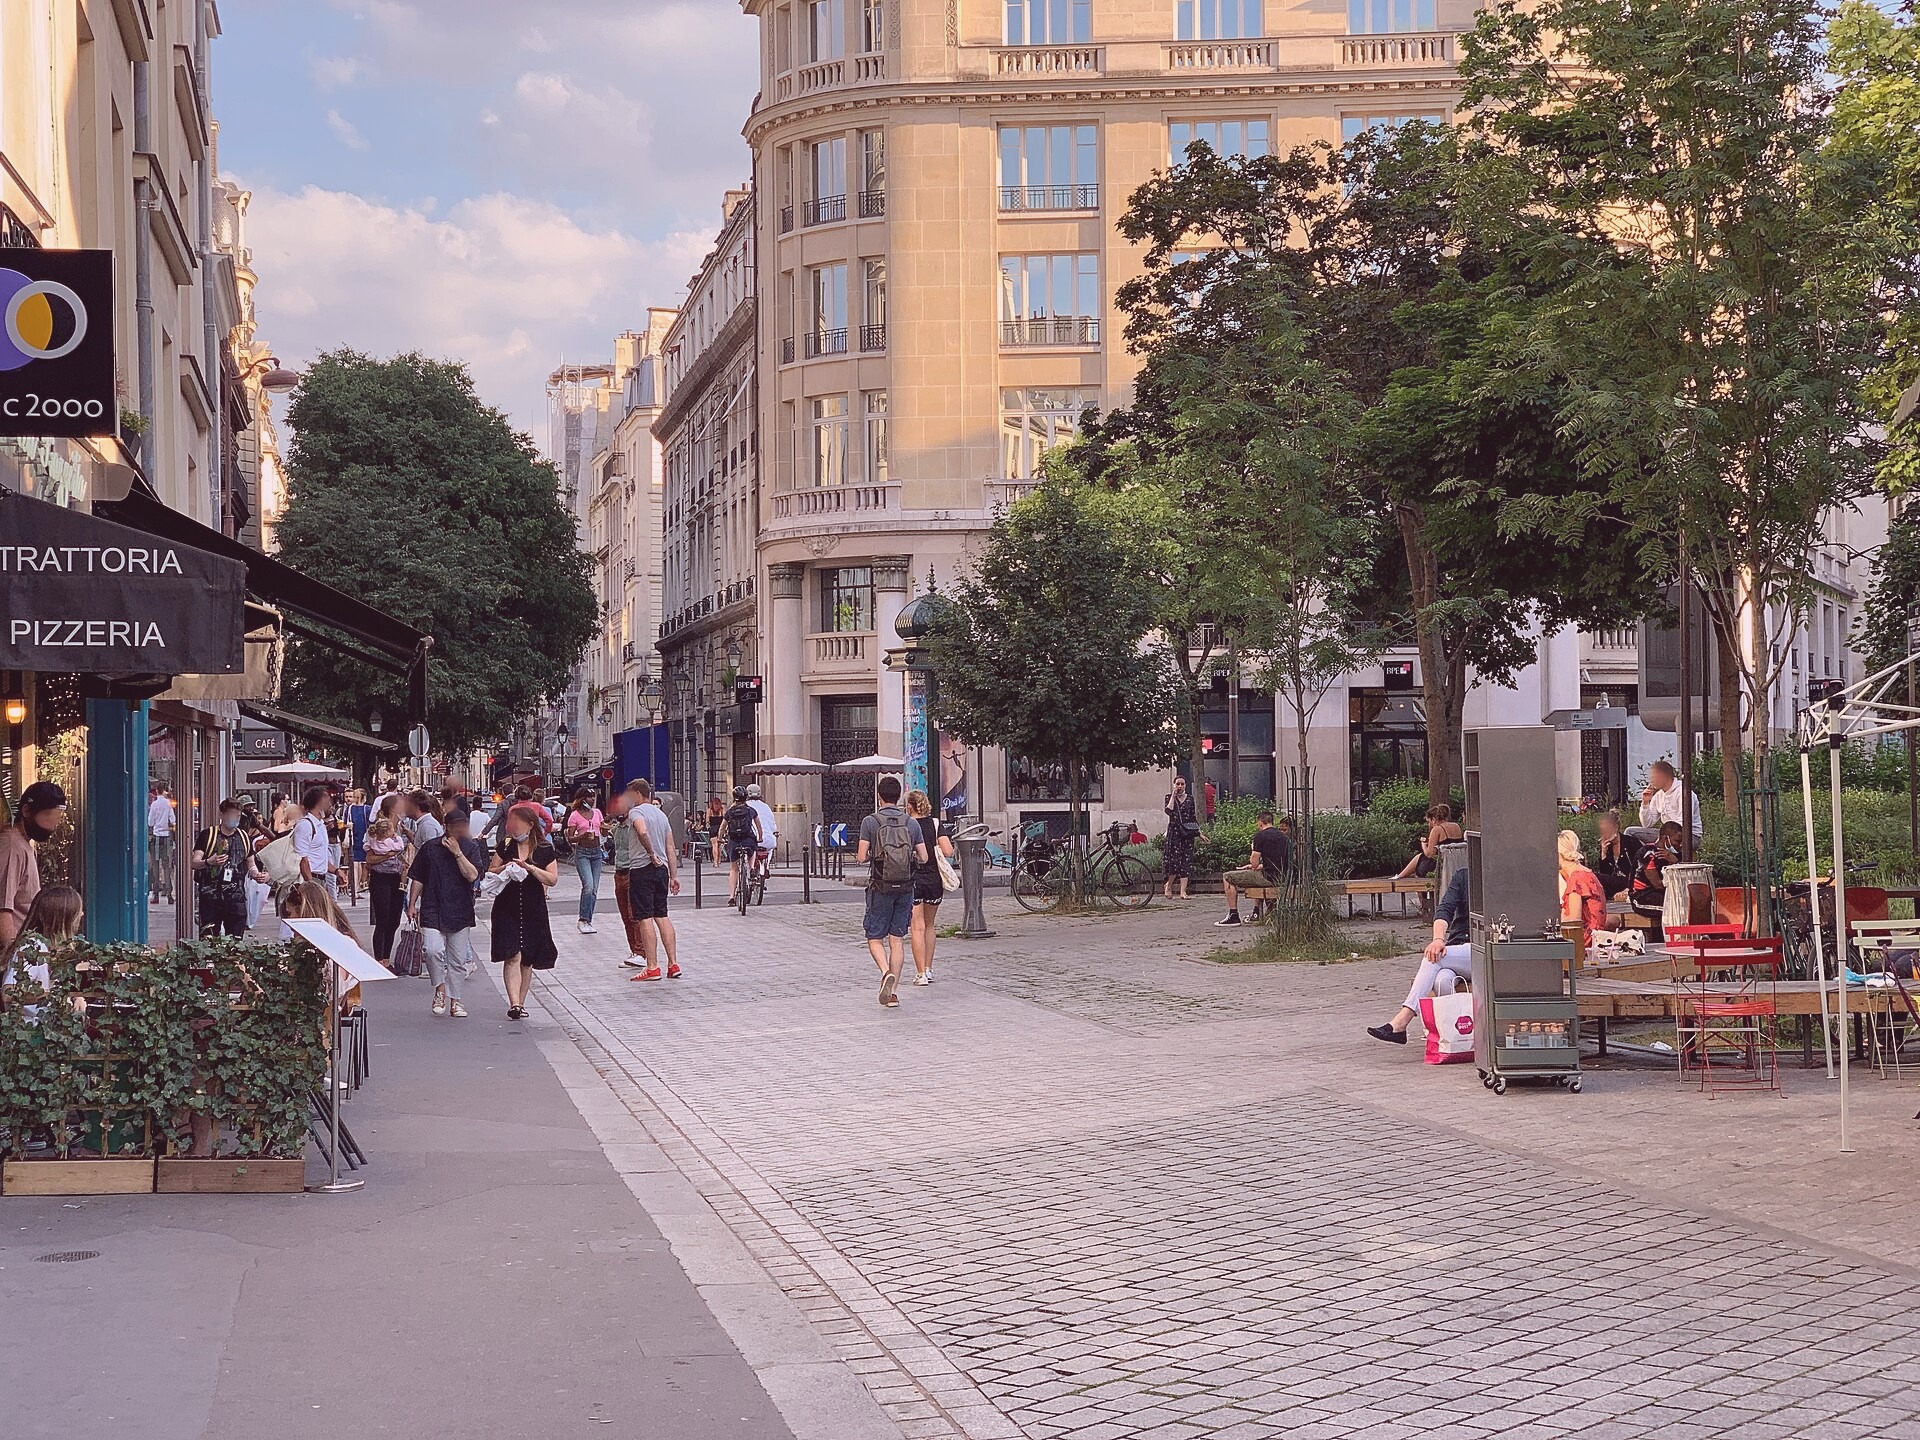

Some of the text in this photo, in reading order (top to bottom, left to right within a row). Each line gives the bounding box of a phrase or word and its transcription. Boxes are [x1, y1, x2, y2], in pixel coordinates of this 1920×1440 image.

[25, 393, 104, 418] 2000
[0, 546, 183, 575] TRATTORIA
[11, 619, 166, 648] PIZZERIA
[737, 681, 750, 689] BPE
[255, 737, 276, 749] CAFÉ
